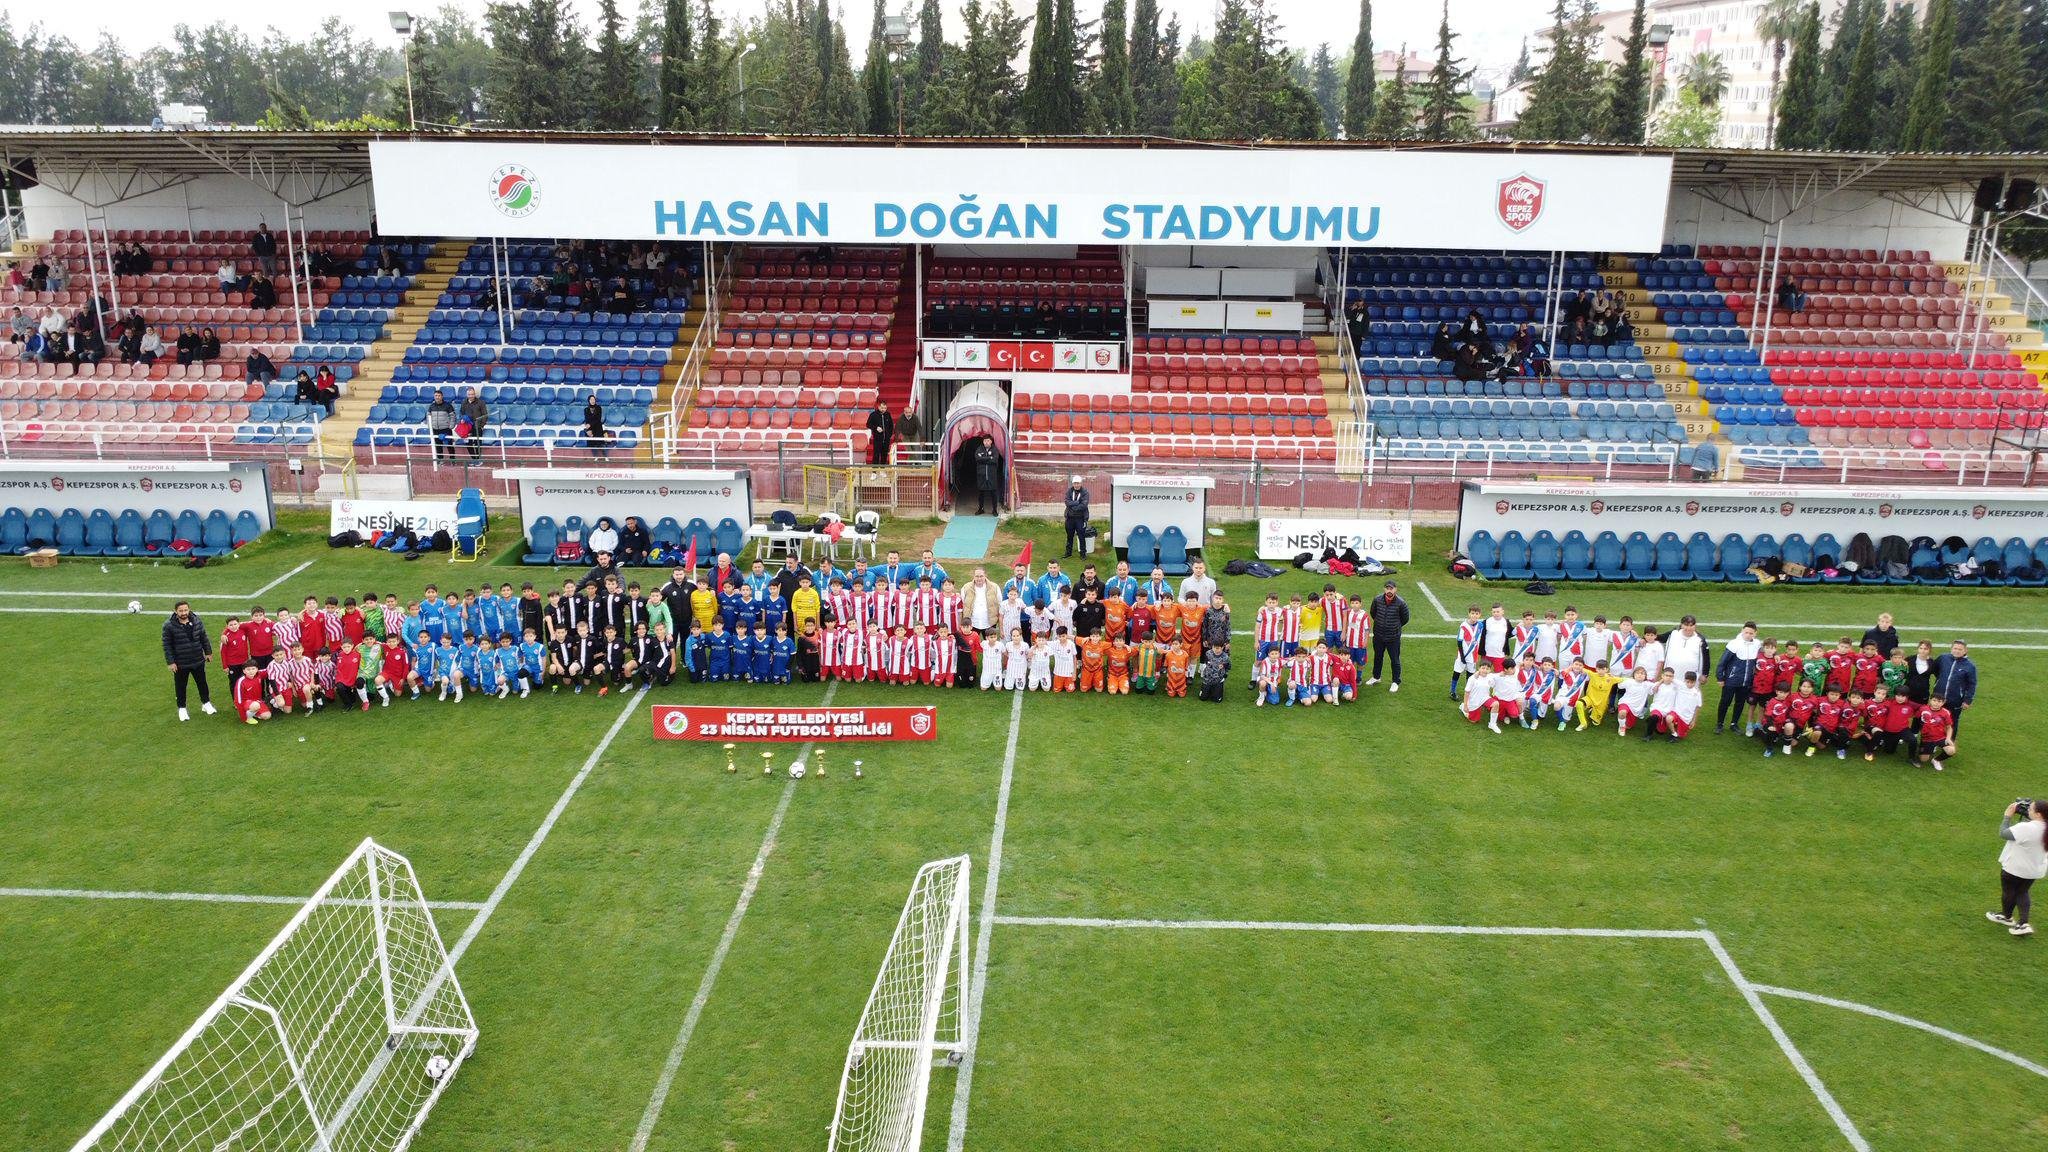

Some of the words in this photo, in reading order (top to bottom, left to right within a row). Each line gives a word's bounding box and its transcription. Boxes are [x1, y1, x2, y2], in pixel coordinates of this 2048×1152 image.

[1506, 204, 1533, 212] KEPEZ
[654, 200, 828, 236] HASAN
[874, 194, 1058, 238] DOĞAN
[1101, 204, 1380, 242] STADYUMU
[1506, 213, 1532, 222] SPOR
[66, 481, 120, 490] KEPEZSPOR
[726, 713, 774, 724] KEPEZ
[778, 710, 864, 724] BELEDİYESİ
[700, 724, 718, 735] 23
[721, 723, 768, 736] NİSAN
[771, 725, 830, 736] FUTBOL
[834, 722, 892, 738] ŞENLİĞİ
